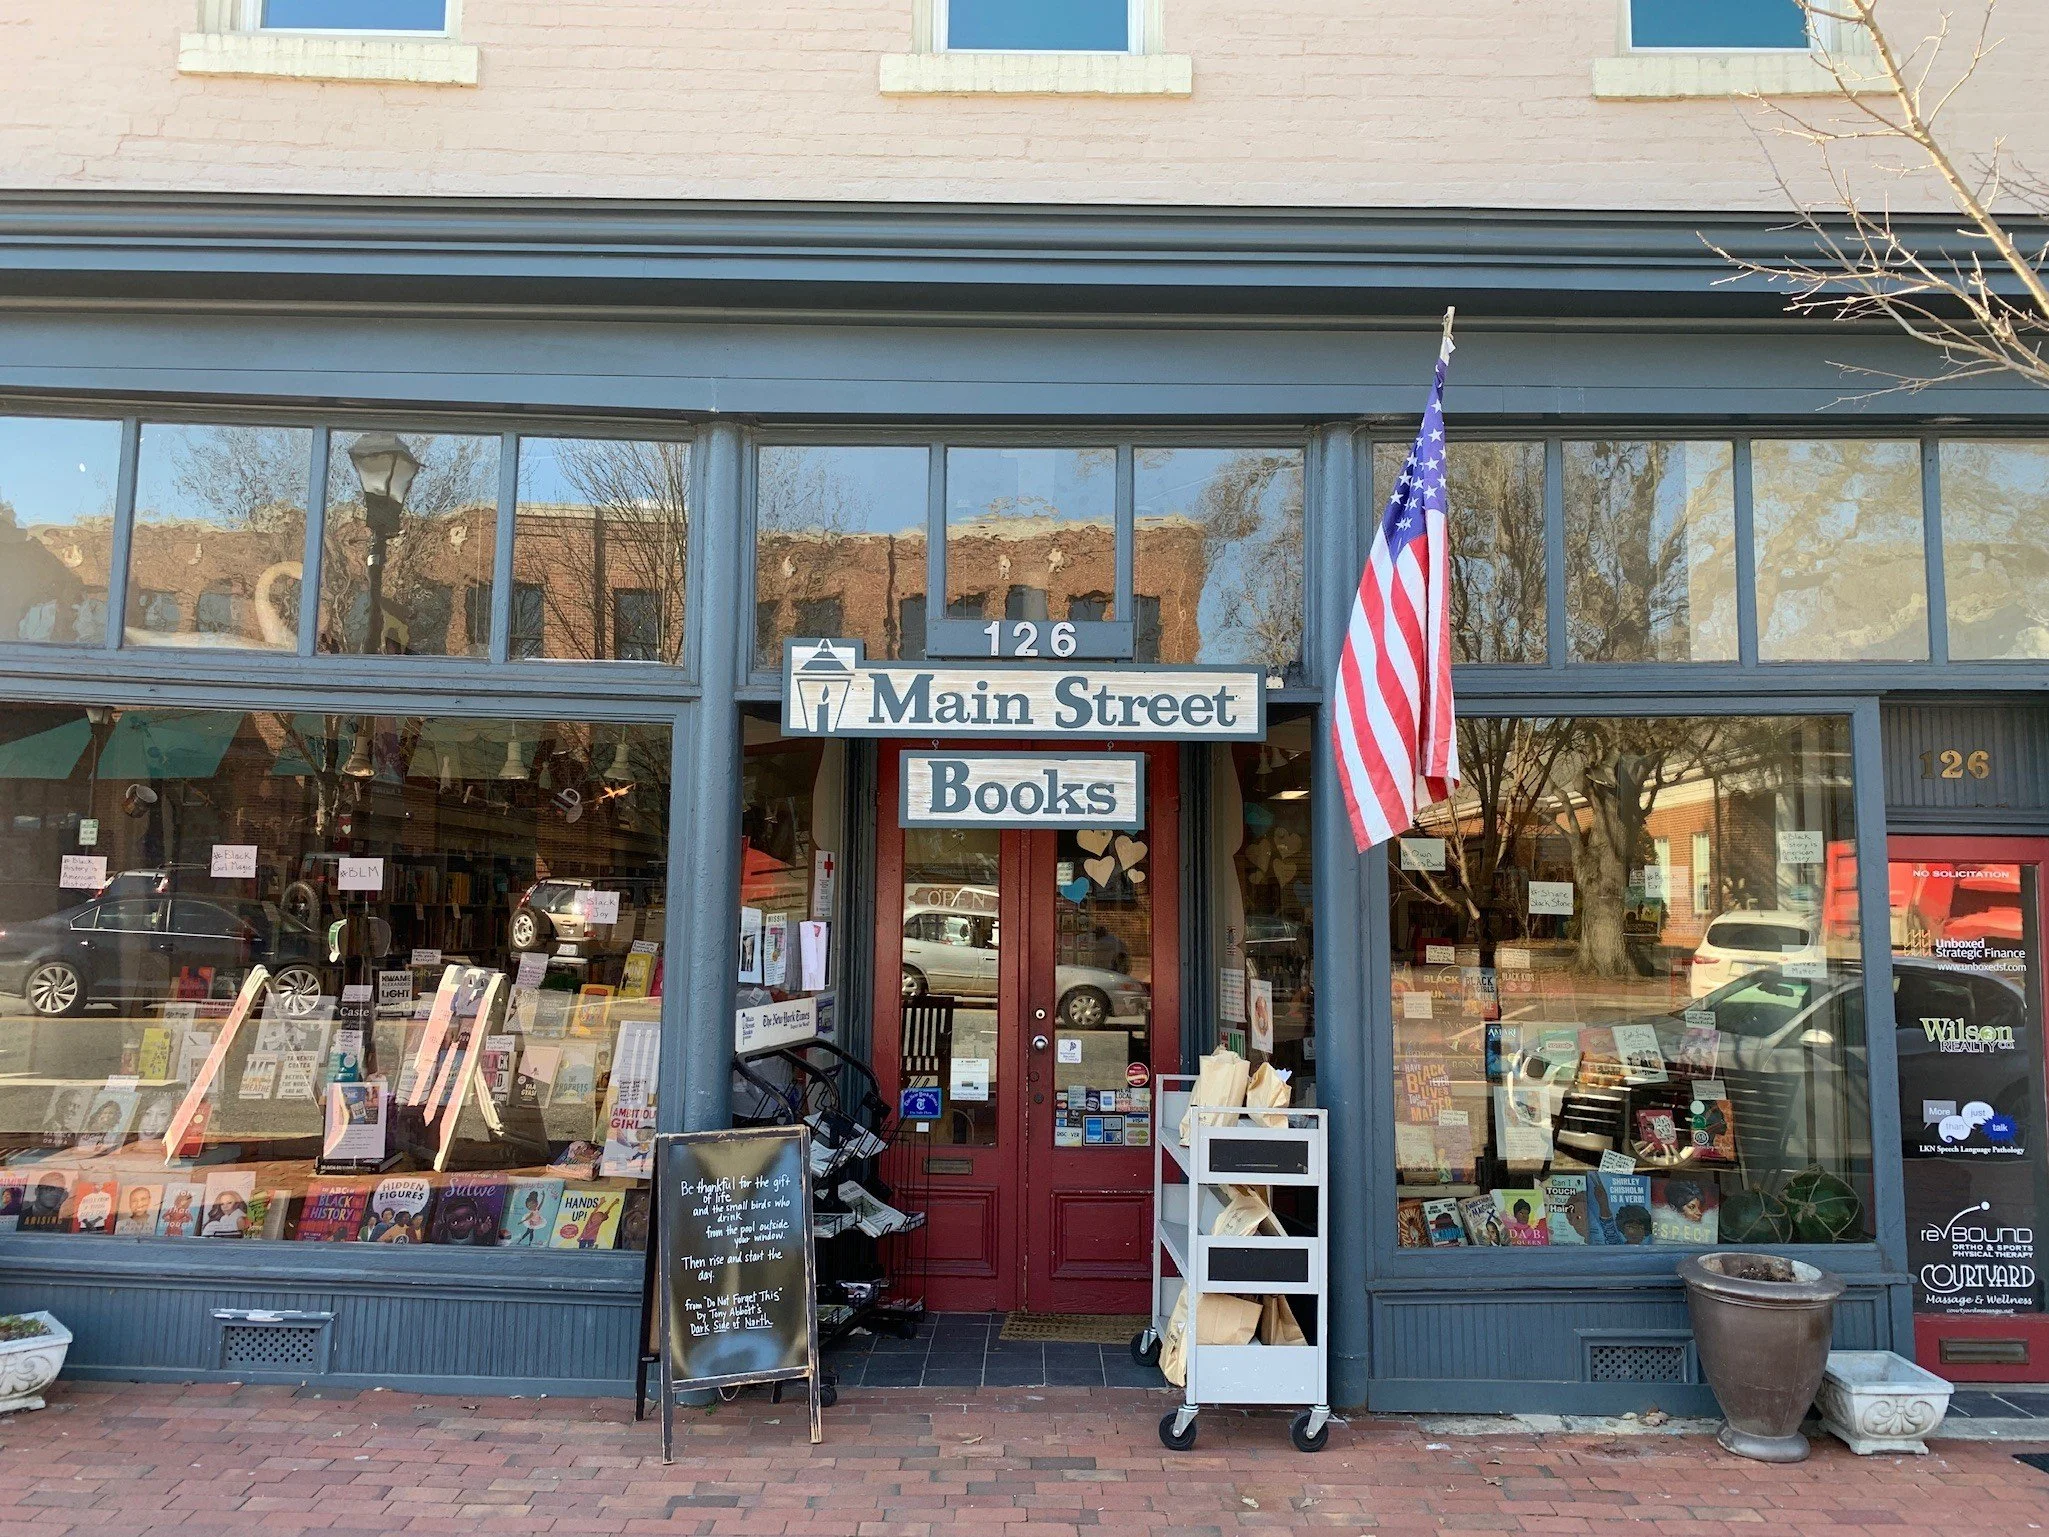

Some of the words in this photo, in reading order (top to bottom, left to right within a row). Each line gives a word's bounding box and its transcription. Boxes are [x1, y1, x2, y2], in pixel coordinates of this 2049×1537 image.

[984, 621, 1077, 657] 126
[868, 673, 1034, 724] Main
[1055, 676, 1236, 728] Street
[1920, 750, 1991, 780] 126
[927, 760, 1116, 814] Books
[340, 866, 379, 878] #BLM
[1932, 870, 2010, 878] SOLICITATION
[593, 908, 609, 918] Joy
[1935, 938, 1985, 948] Unboxed
[1936, 948, 1982, 960] Strategic
[1984, 948, 2026, 958] Finance
[1937, 962, 2027, 972] www.unboxedsf.com
[1423, 975, 1459, 984] BLACK
[1465, 976, 1494, 986] BLACK
[340, 1006, 370, 1016] Caste
[1488, 1028, 1516, 1037] AMARI
[1919, 1018, 2015, 1042] Wilson
[1940, 1041, 1998, 1052] REALTY
[1406, 1064, 1446, 1093] BLACK
[1421, 1086, 1449, 1100] LIVES
[612, 1108, 657, 1119] AMBITIOU
[1410, 1096, 1453, 1122] MATTER
[1928, 1107, 1950, 1116] More
[1970, 1108, 1986, 1118] just
[610, 1118, 640, 1130] GIRL
[1946, 1122, 1964, 1130] than
[1992, 1123, 2008, 1132] talk
[1936, 1145, 1960, 1154] Speech
[1960, 1146, 1992, 1155] Language
[1992, 1146, 2026, 1156] Pathology
[383, 1180, 424, 1192] HIDDEN
[445, 1178, 498, 1198] Sulwe
[681, 1180, 694, 1196] Be
[696, 1176, 736, 1194] thankful
[739, 1175, 752, 1189] for
[755, 1175, 769, 1189] the
[773, 1174, 791, 1192] gift
[380, 1190, 424, 1200] FIGURES
[703, 1193, 712, 1204] of
[715, 1192, 732, 1203] life
[318, 1195, 353, 1208] BLACK
[565, 1197, 599, 1209] HANDS
[693, 1205, 709, 1216] and
[712, 1204, 724, 1214] the
[726, 1199, 748, 1212] small
[751, 1198, 771, 1210] birds
[774, 1195, 790, 1208] who
[310, 1208, 355, 1220] HISTORY
[1550, 1205, 1576, 1213] Hair?
[572, 1211, 588, 1222] UP!
[717, 1212, 743, 1223] drink
[706, 1226, 723, 1239] from
[726, 1224, 738, 1236] the
[740, 1221, 755, 1238] pool
[759, 1219, 789, 1231] outside
[1534, 1230, 1544, 1239] B.
[1652, 1222, 1711, 1242] ESPECT
[734, 1237, 750, 1249] your
[754, 1231, 786, 1242] window.
[681, 1256, 705, 1270] Then
[709, 1254, 724, 1266] rise
[727, 1251, 743, 1264] and
[745, 1250, 764, 1262] start
[767, 1248, 783, 1260] the
[698, 1270, 715, 1283] day.
[1921, 1264, 2035, 1293] COURTYARD
[685, 1298, 702, 1311] from
[717, 1294, 730, 1306] Not
[732, 1291, 757, 1307] Forget
[1926, 1294, 1973, 1306] Massage
[1974, 1295, 1984, 1304] &
[1986, 1294, 2032, 1305] Wellness
[696, 1311, 706, 1324] by
[709, 1309, 726, 1320] Tony
[729, 1303, 762, 1317] Abbott's
[690, 1322, 710, 1336] Dark
[713, 1320, 730, 1332] Side
[732, 1318, 740, 1329] of
[745, 1313, 774, 1329] North
